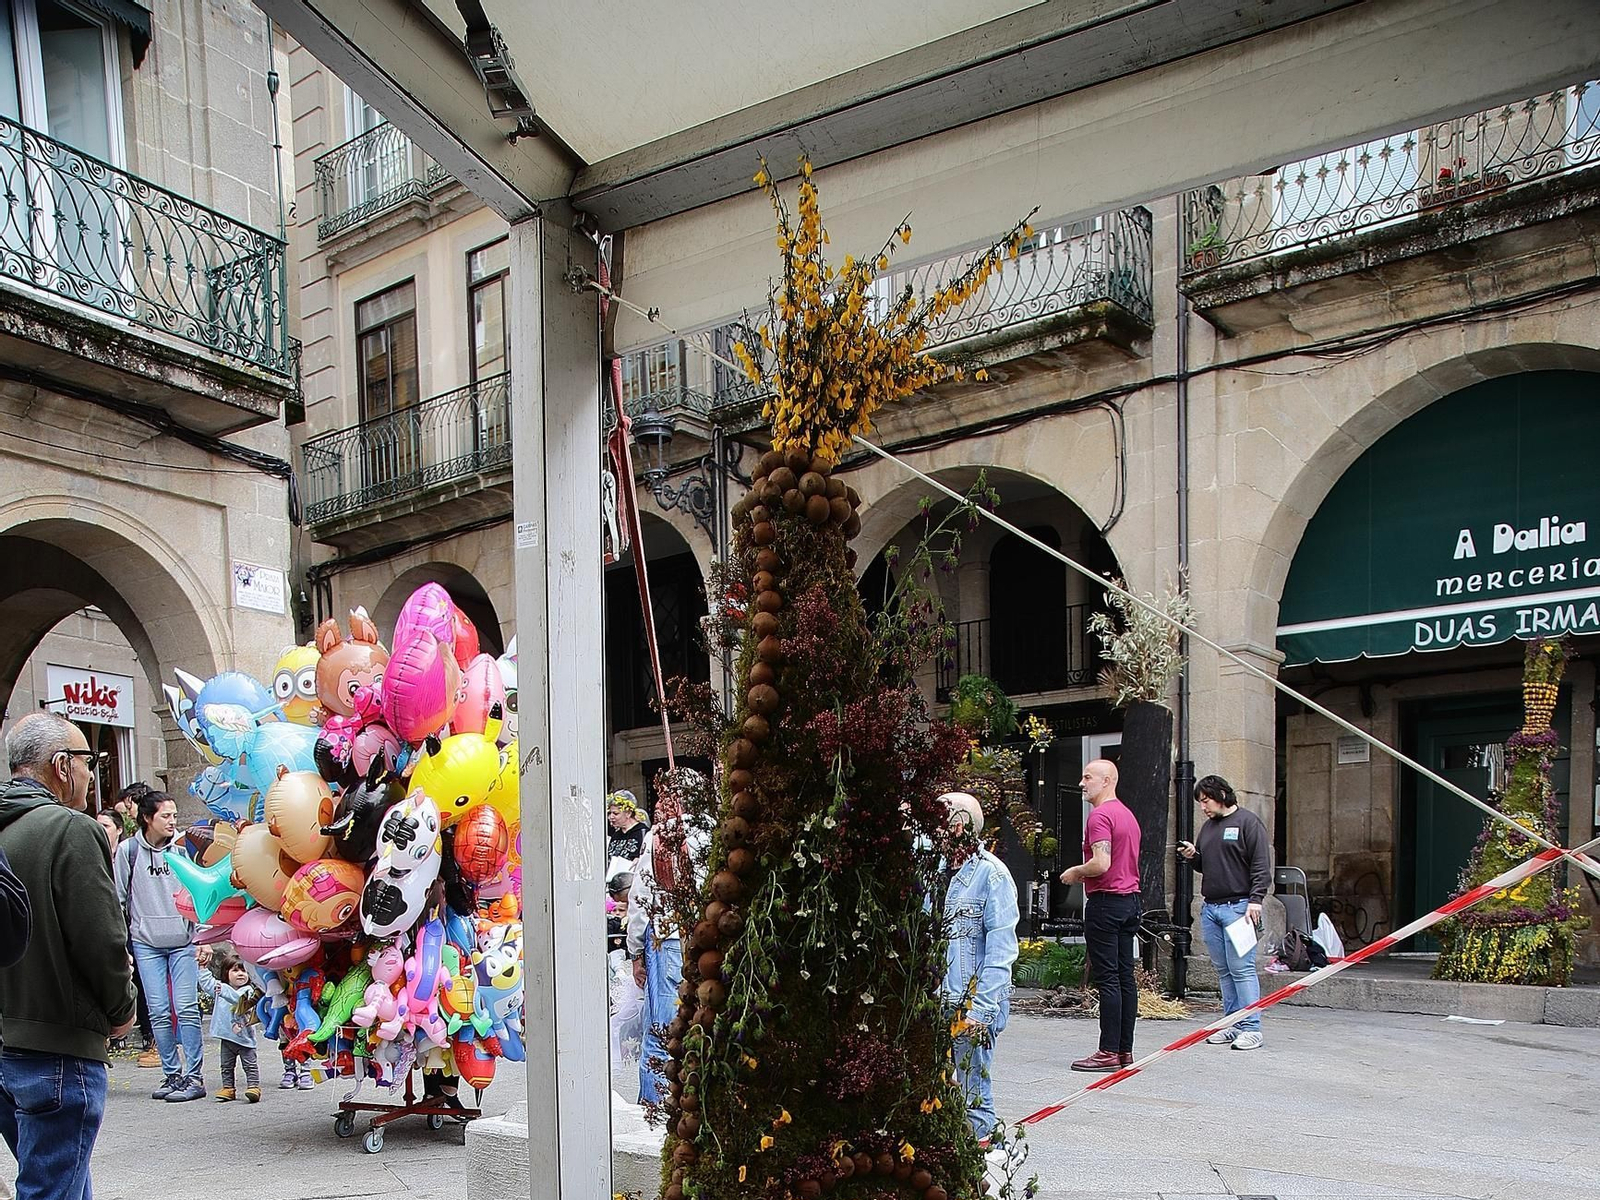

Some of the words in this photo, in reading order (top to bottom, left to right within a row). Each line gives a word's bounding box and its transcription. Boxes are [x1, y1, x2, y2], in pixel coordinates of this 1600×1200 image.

[1453, 529, 1477, 560] A
[1492, 515, 1586, 554] Dalia
[1414, 614, 1497, 647] DUAS
[63, 675, 118, 708] Nikis
